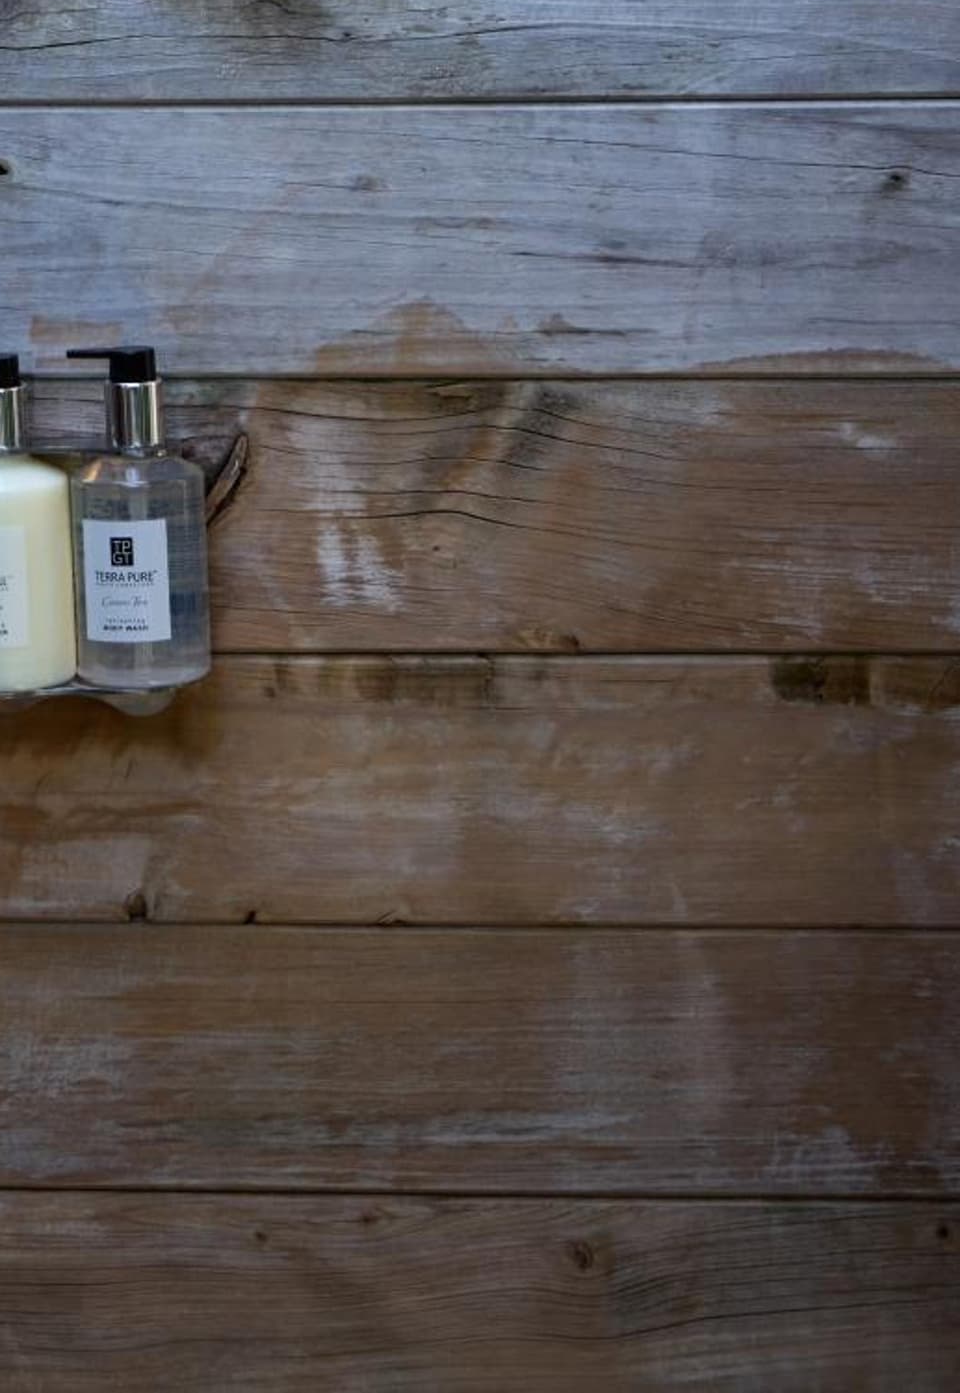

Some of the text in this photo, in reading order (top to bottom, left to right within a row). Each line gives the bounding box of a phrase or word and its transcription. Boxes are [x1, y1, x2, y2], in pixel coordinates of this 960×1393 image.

[111, 540, 131, 553] TP
[112, 552, 132, 565] GT
[95, 570, 126, 582] TERRA
